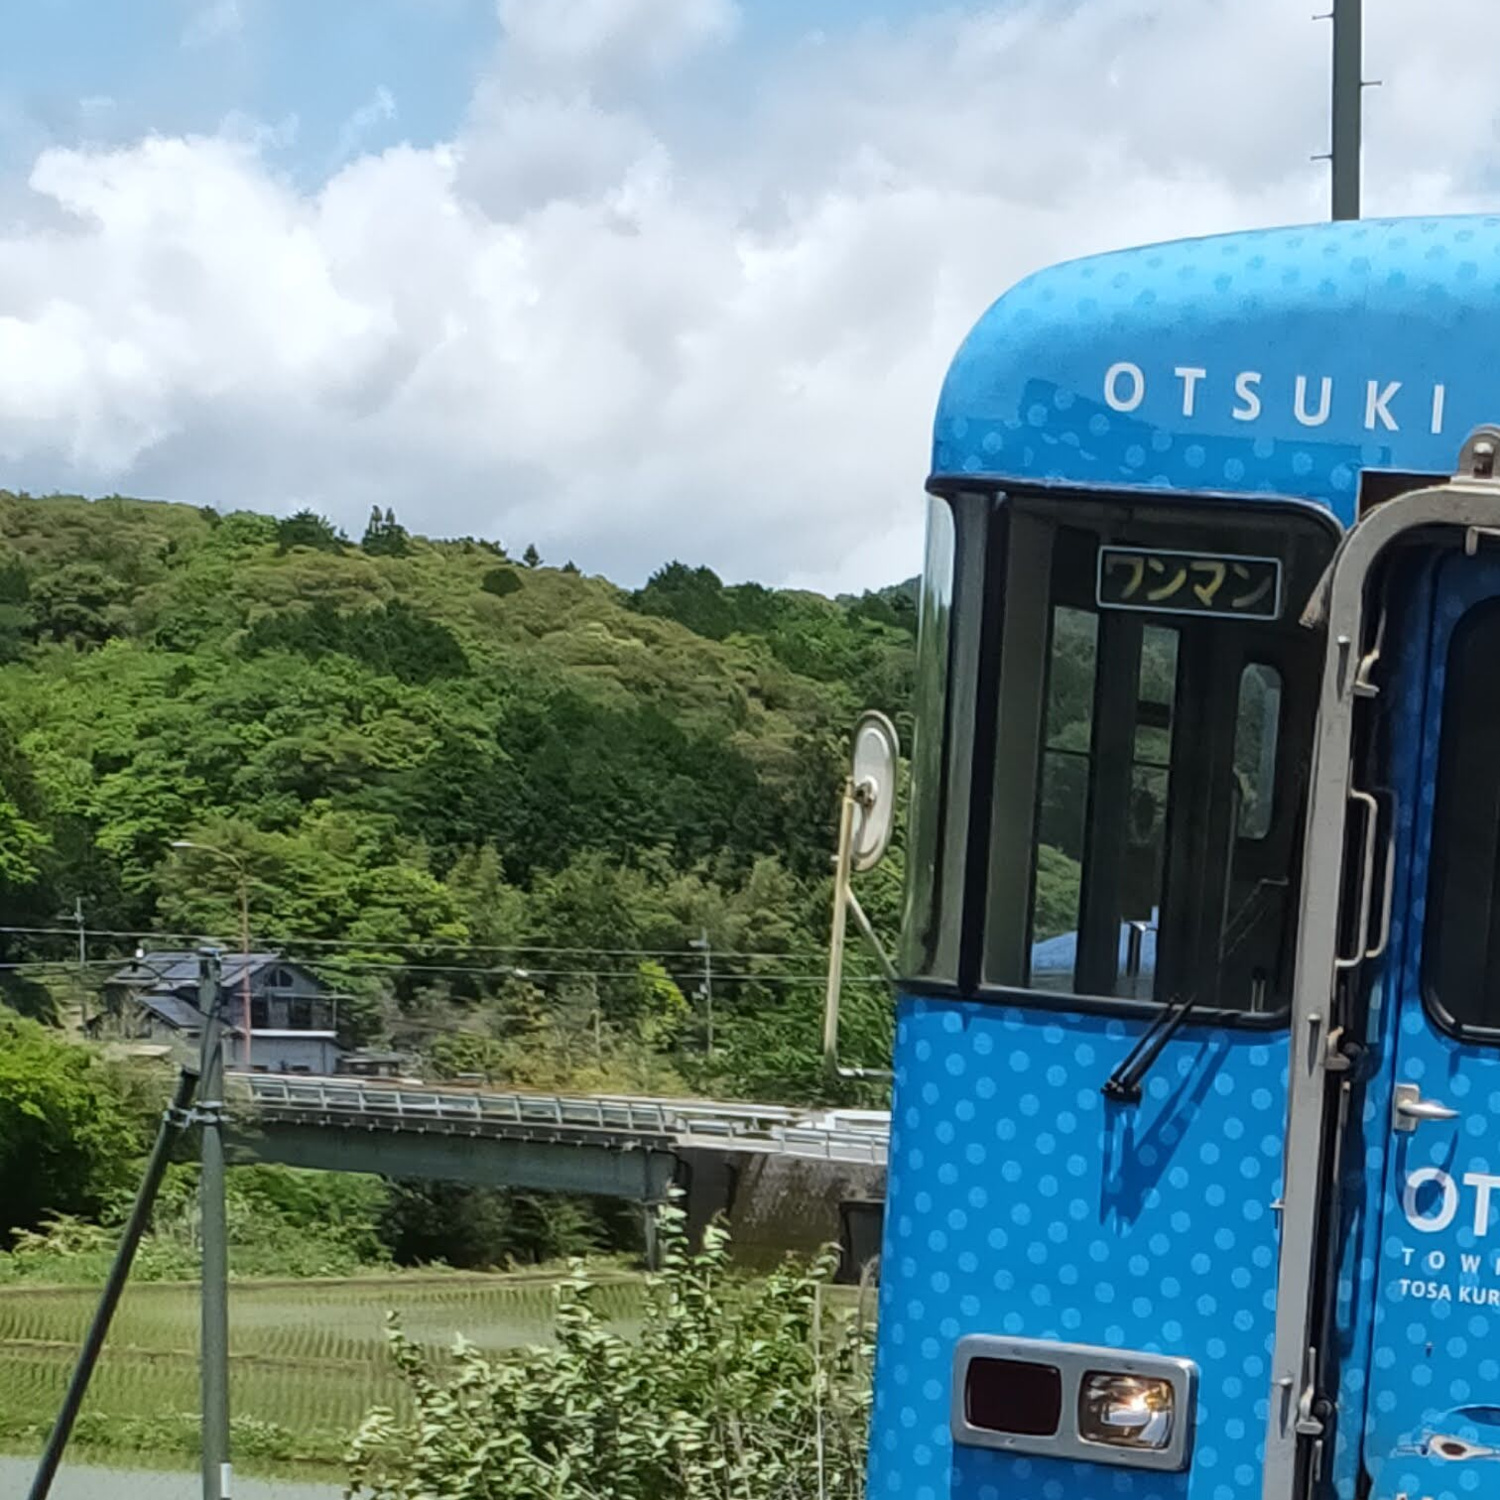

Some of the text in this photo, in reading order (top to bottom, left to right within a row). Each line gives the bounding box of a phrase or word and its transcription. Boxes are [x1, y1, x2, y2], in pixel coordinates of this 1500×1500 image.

[1103, 362, 1446, 435] OTSUKI
[1104, 555, 1272, 606] ワンマン
[1401, 1278, 1451, 1301] TOSA
